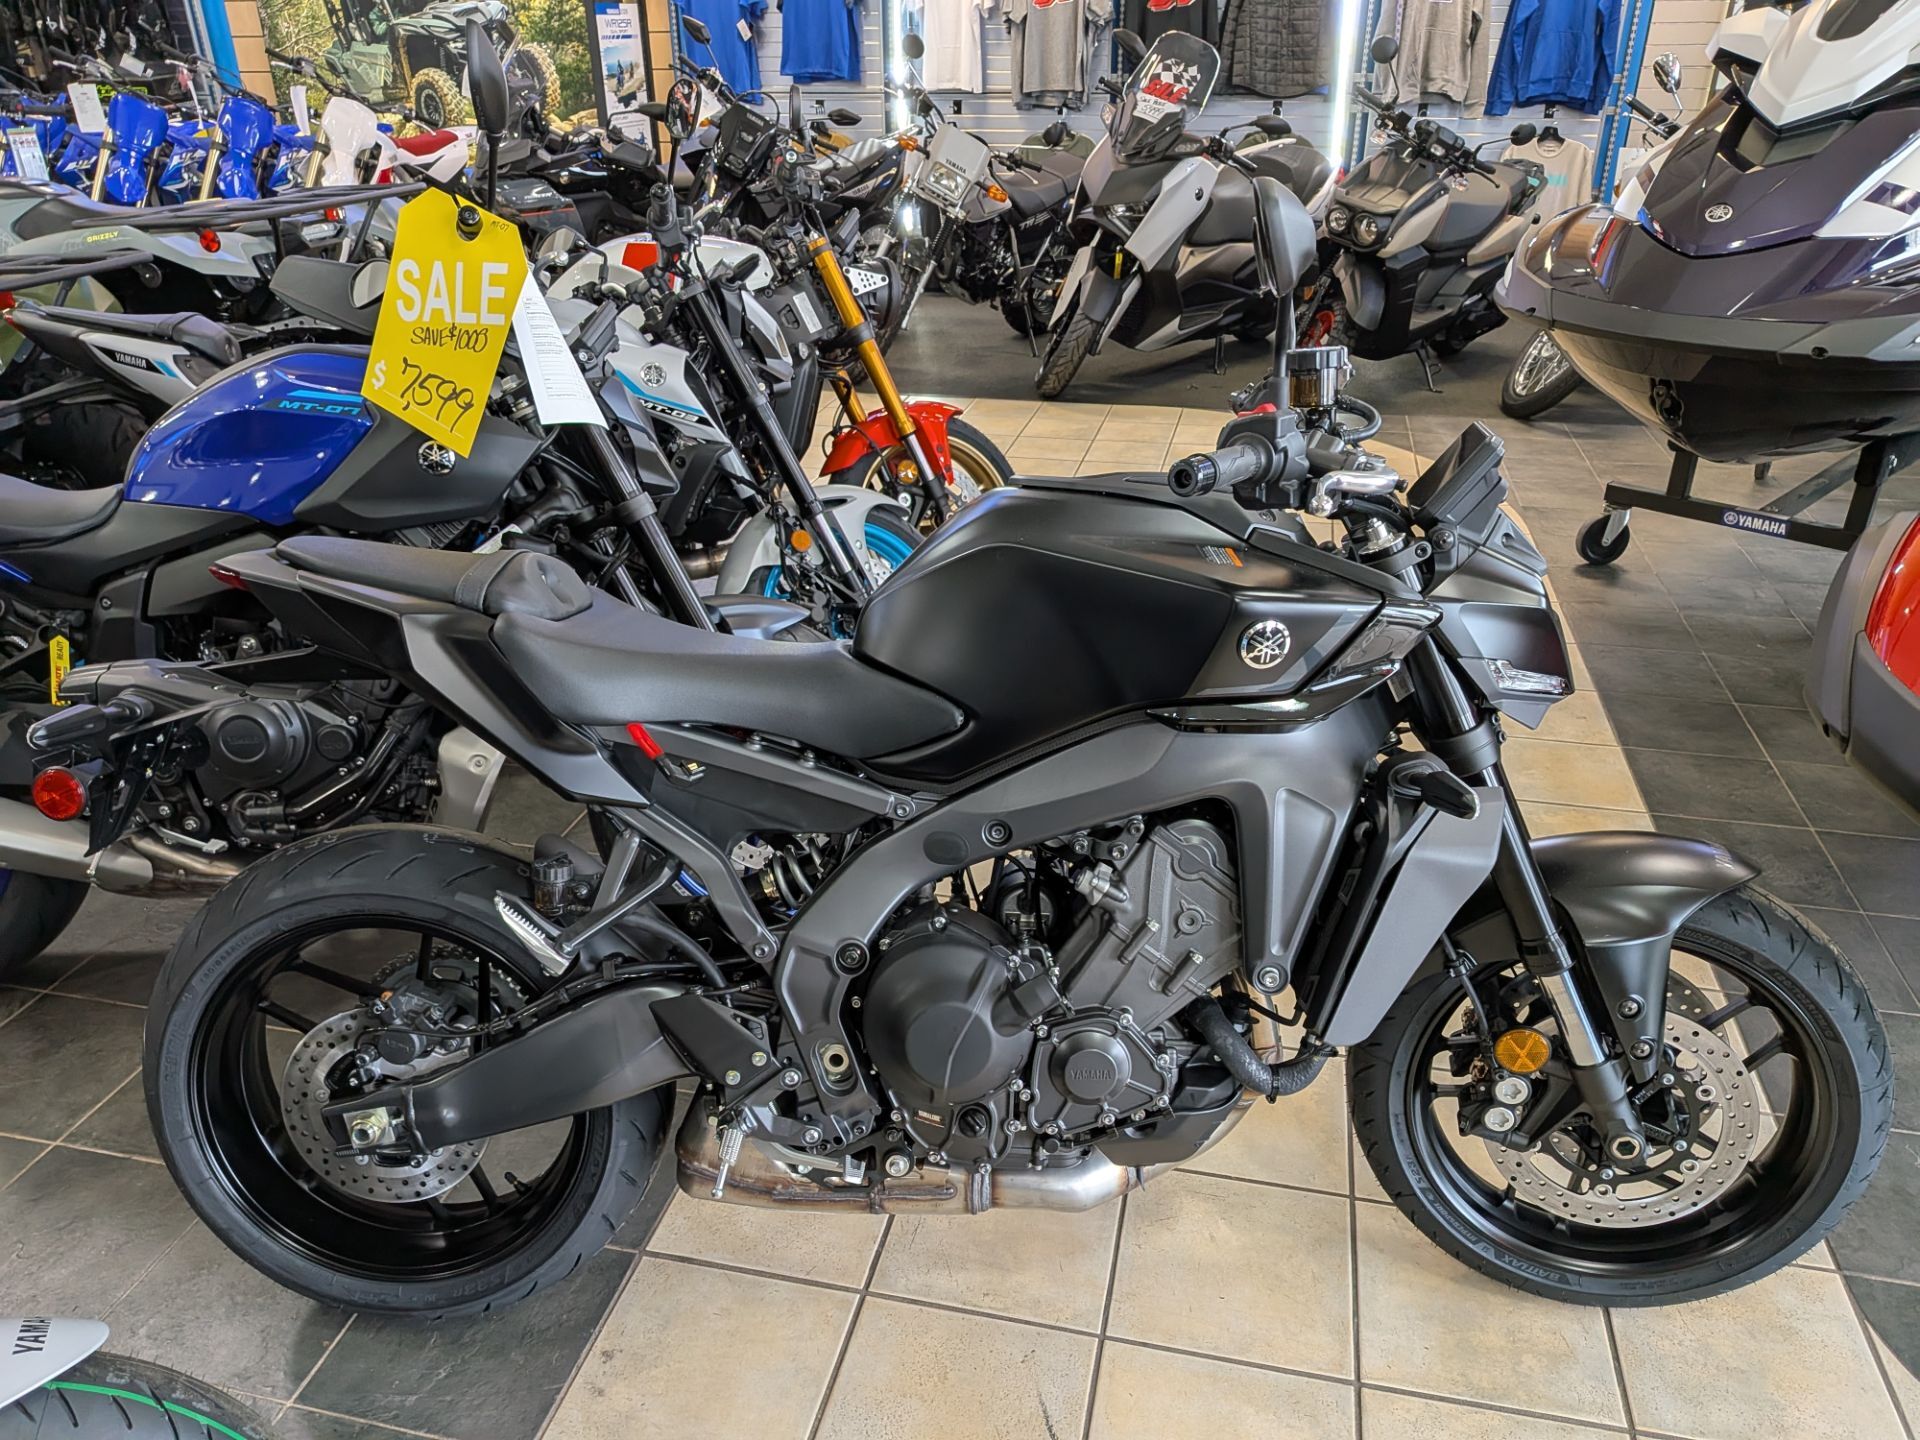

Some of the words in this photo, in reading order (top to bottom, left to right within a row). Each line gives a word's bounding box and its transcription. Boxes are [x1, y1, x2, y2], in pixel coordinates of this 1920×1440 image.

[1143, 79, 1190, 105] SALE
[945, 158, 967, 175] YAMAHA
[86, 231, 119, 243] GRIZZLY
[396, 258, 509, 326] SALE
[114, 351, 147, 369] YAMAHA
[278, 400, 361, 415] MT-07
[640, 399, 699, 422] MT-03
[1738, 514, 1787, 536] YAMAHA
[1070, 1069, 1112, 1081] YAMAHA
[1501, 1253, 1561, 1283] BATTLAX
